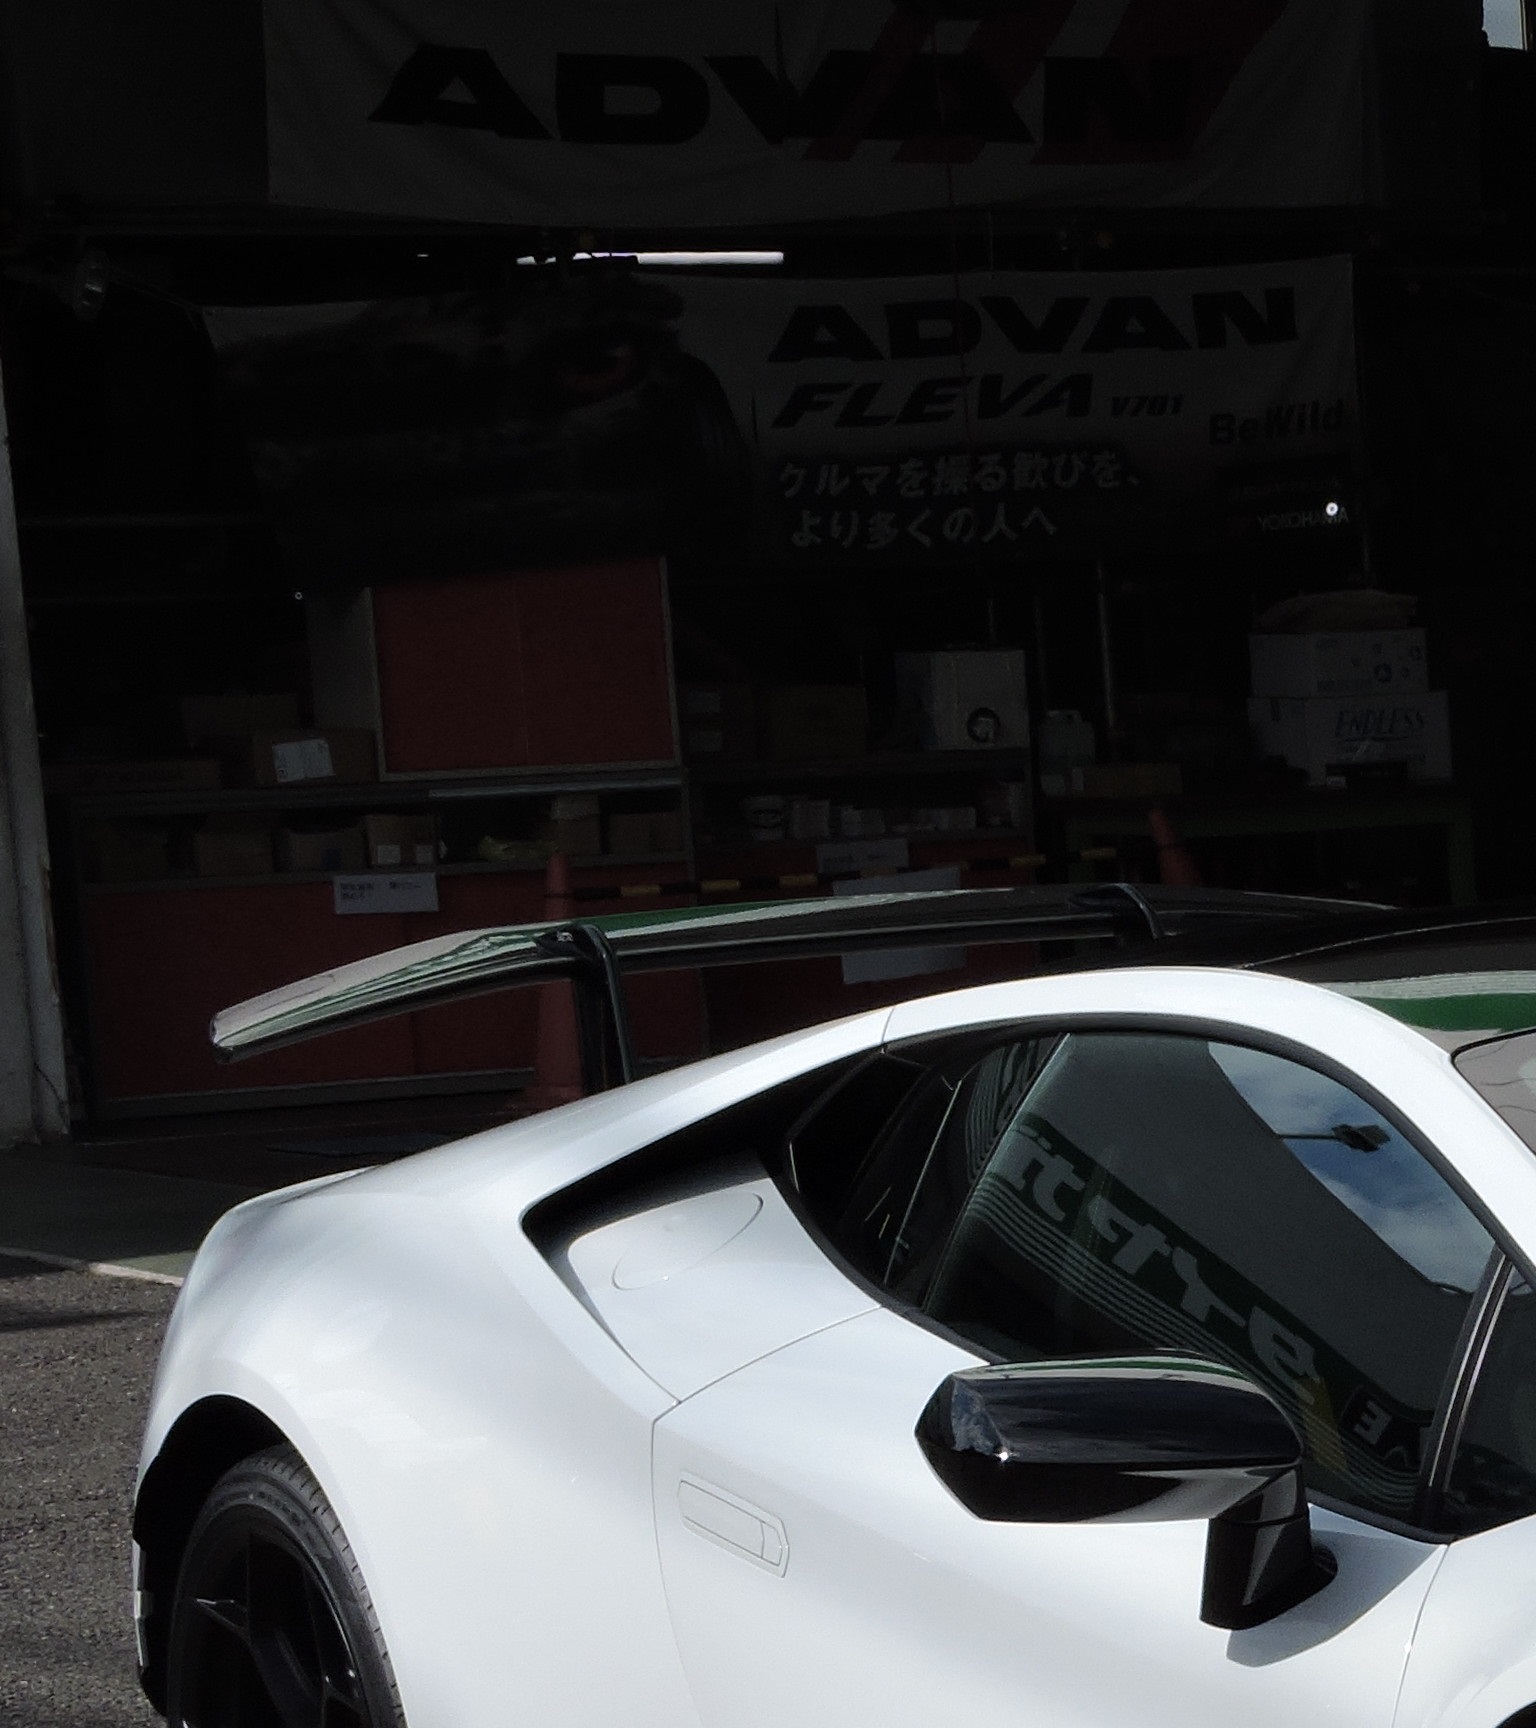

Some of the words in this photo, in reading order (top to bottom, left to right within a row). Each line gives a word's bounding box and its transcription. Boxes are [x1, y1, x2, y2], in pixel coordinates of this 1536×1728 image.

[367, 41, 1194, 147] ADVAN
[767, 286, 1299, 364] ADVAN
[771, 371, 1094, 430] FLEVA
